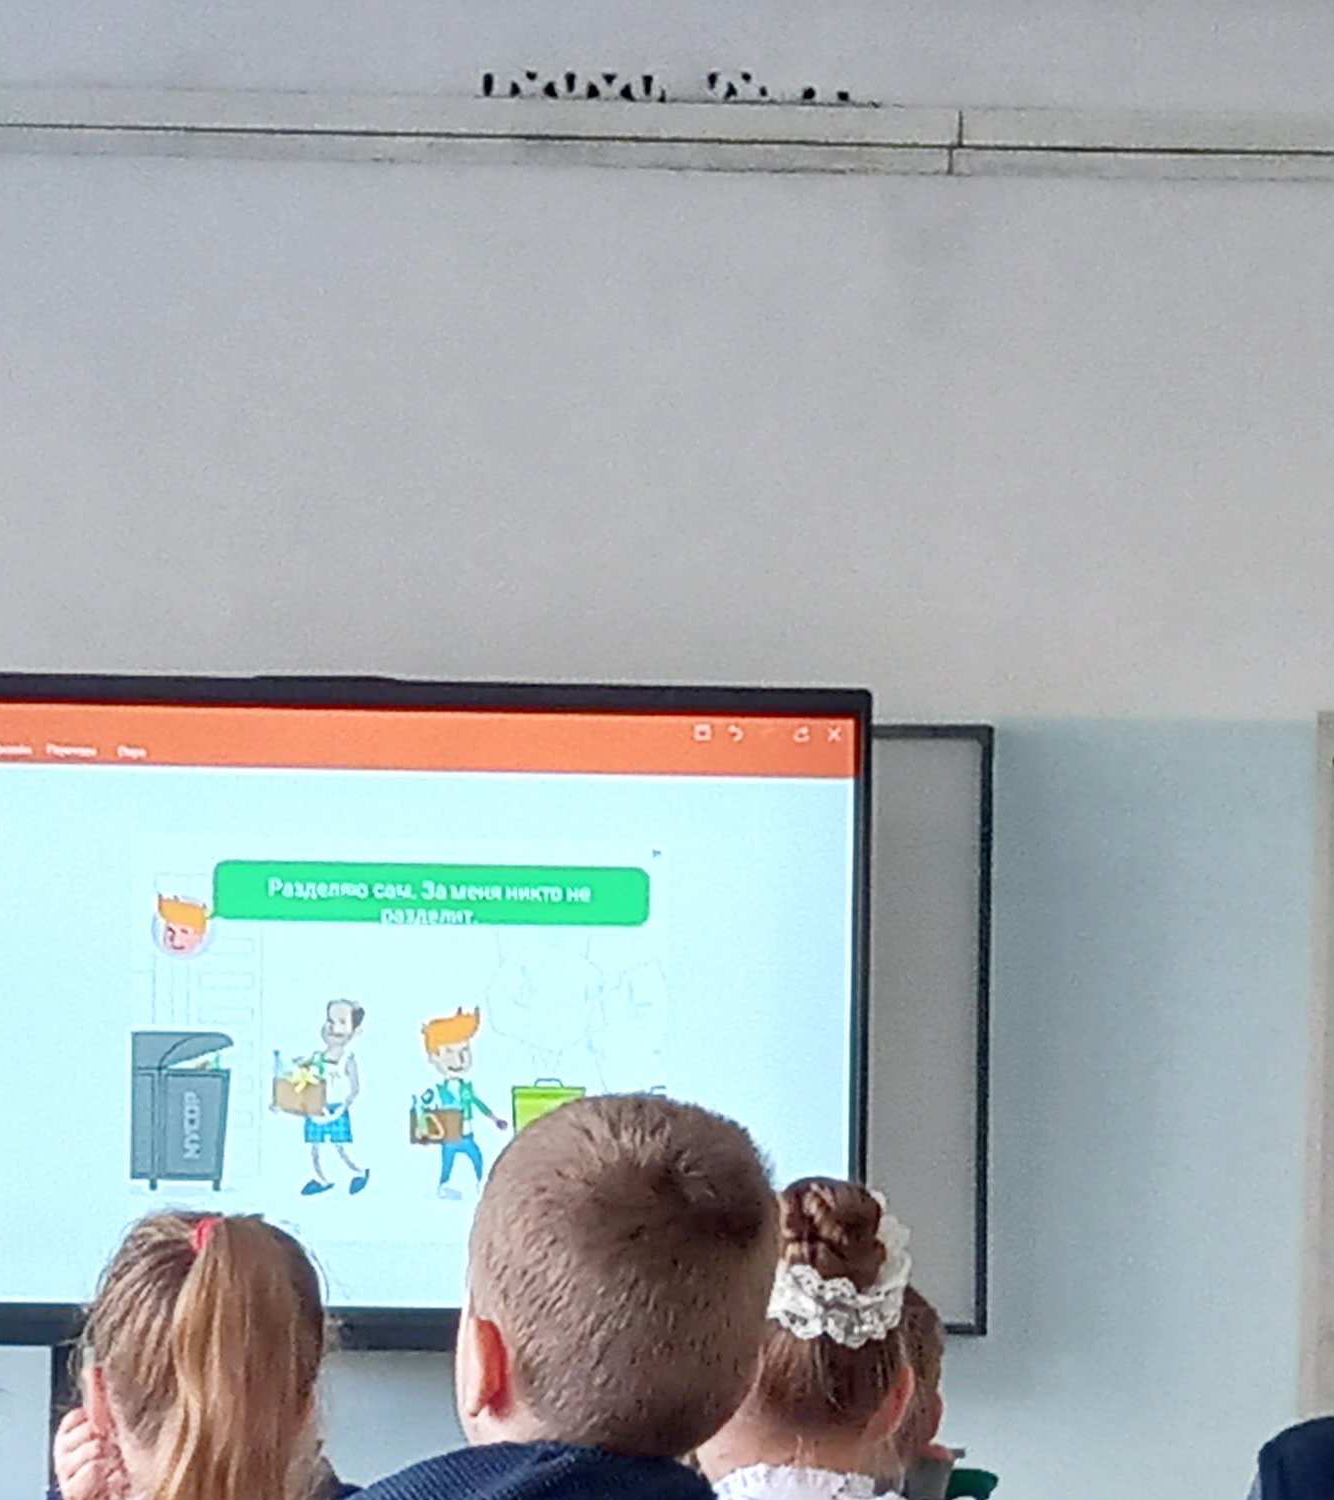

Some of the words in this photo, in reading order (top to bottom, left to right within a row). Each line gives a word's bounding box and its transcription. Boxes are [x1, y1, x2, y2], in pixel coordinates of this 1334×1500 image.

[267, 877, 369, 901] Разделяю
[421, 880, 447, 901] За
[450, 885, 502, 901] меня
[505, 885, 563, 902] никто
[566, 886, 592, 902] не
[183, 1091, 201, 1160] МУСОР
